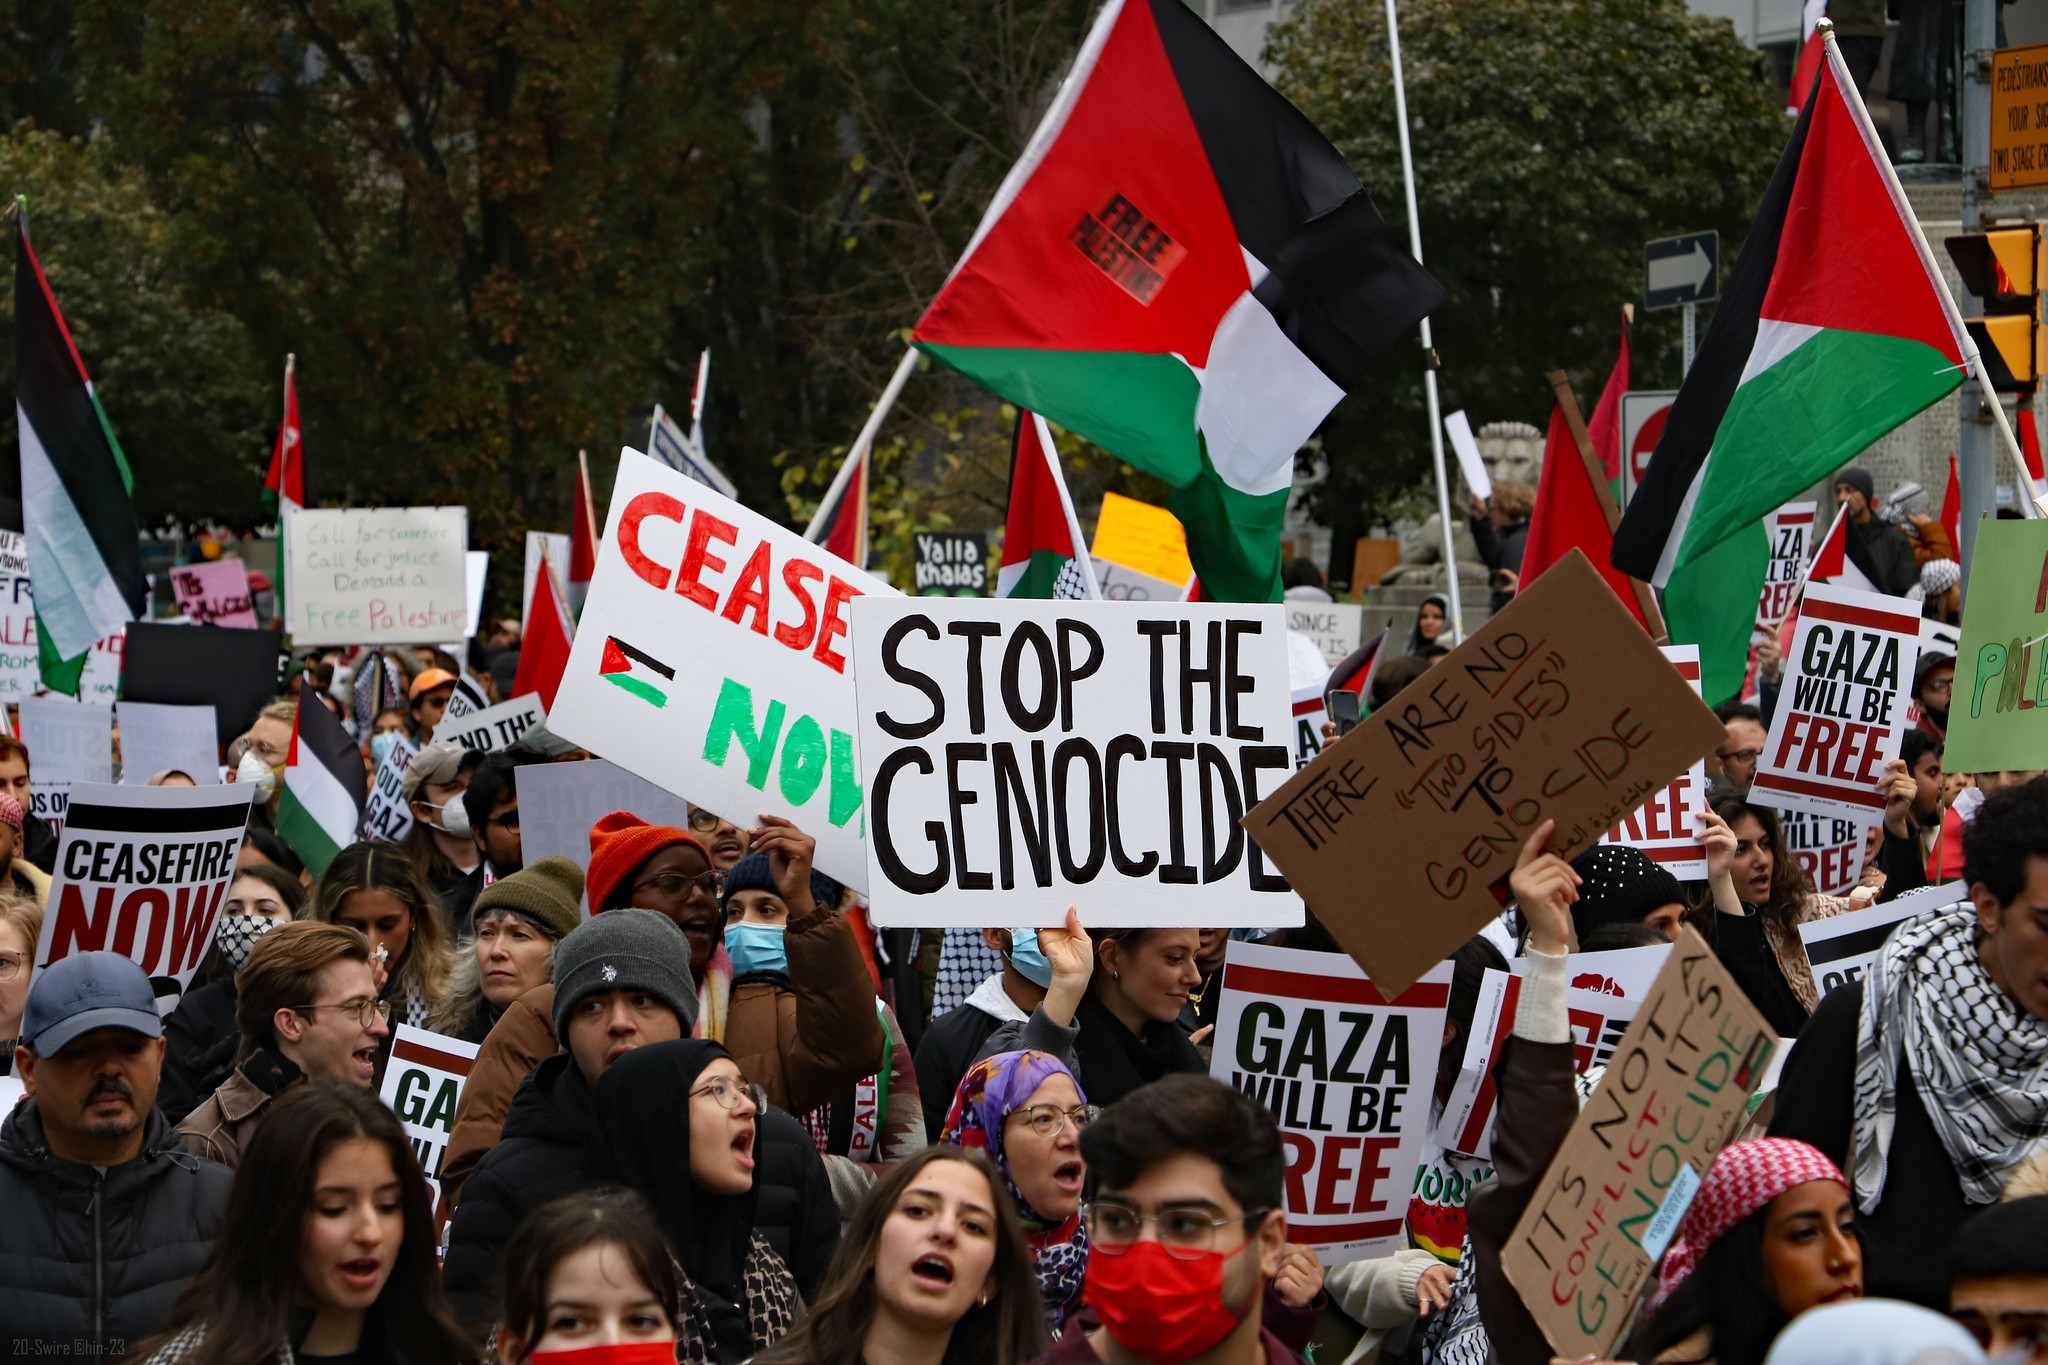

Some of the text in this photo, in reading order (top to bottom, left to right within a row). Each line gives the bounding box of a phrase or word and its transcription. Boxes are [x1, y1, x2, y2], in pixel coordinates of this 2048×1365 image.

[2008, 105, 2028, 132] YOUR
[1993, 149, 2009, 174] TWO
[2013, 145, 2035, 172] STAGE
[1099, 193, 1174, 266] FREE
[307, 524, 345, 545] Call
[355, 518, 384, 548] for
[307, 551, 345, 569] Call
[353, 550, 380, 572] for
[917, 534, 978, 563] Yalla
[334, 573, 426, 592] Demand a
[617, 491, 865, 675] CEASE
[916, 561, 985, 589] Khalas
[306, 598, 467, 632] Free Palestine
[1291, 612, 1338, 633] SINCE
[875, 614, 1264, 741] STOP THE
[1801, 625, 1900, 690] GAZA
[1792, 675, 1896, 726] WILL BE
[1267, 760, 1379, 851] THERE
[1384, 678, 1469, 768] ARE
[1464, 632, 1529, 695] NO
[1773, 711, 1891, 786] FREE
[871, 734, 1294, 894] GENOCIDE
[1426, 708, 1653, 900] GENOCIDE
[1451, 757, 1514, 816] TO
[63, 837, 239, 885] CEASEFIRE
[47, 881, 227, 978] NOW
[1235, 1001, 1410, 1085] GAZA
[1590, 991, 1668, 1151] NOT
[1681, 953, 1709, 997] A
[1346, 1083, 1408, 1133] BE
[1577, 1011, 1752, 1336] GENOCIDE
